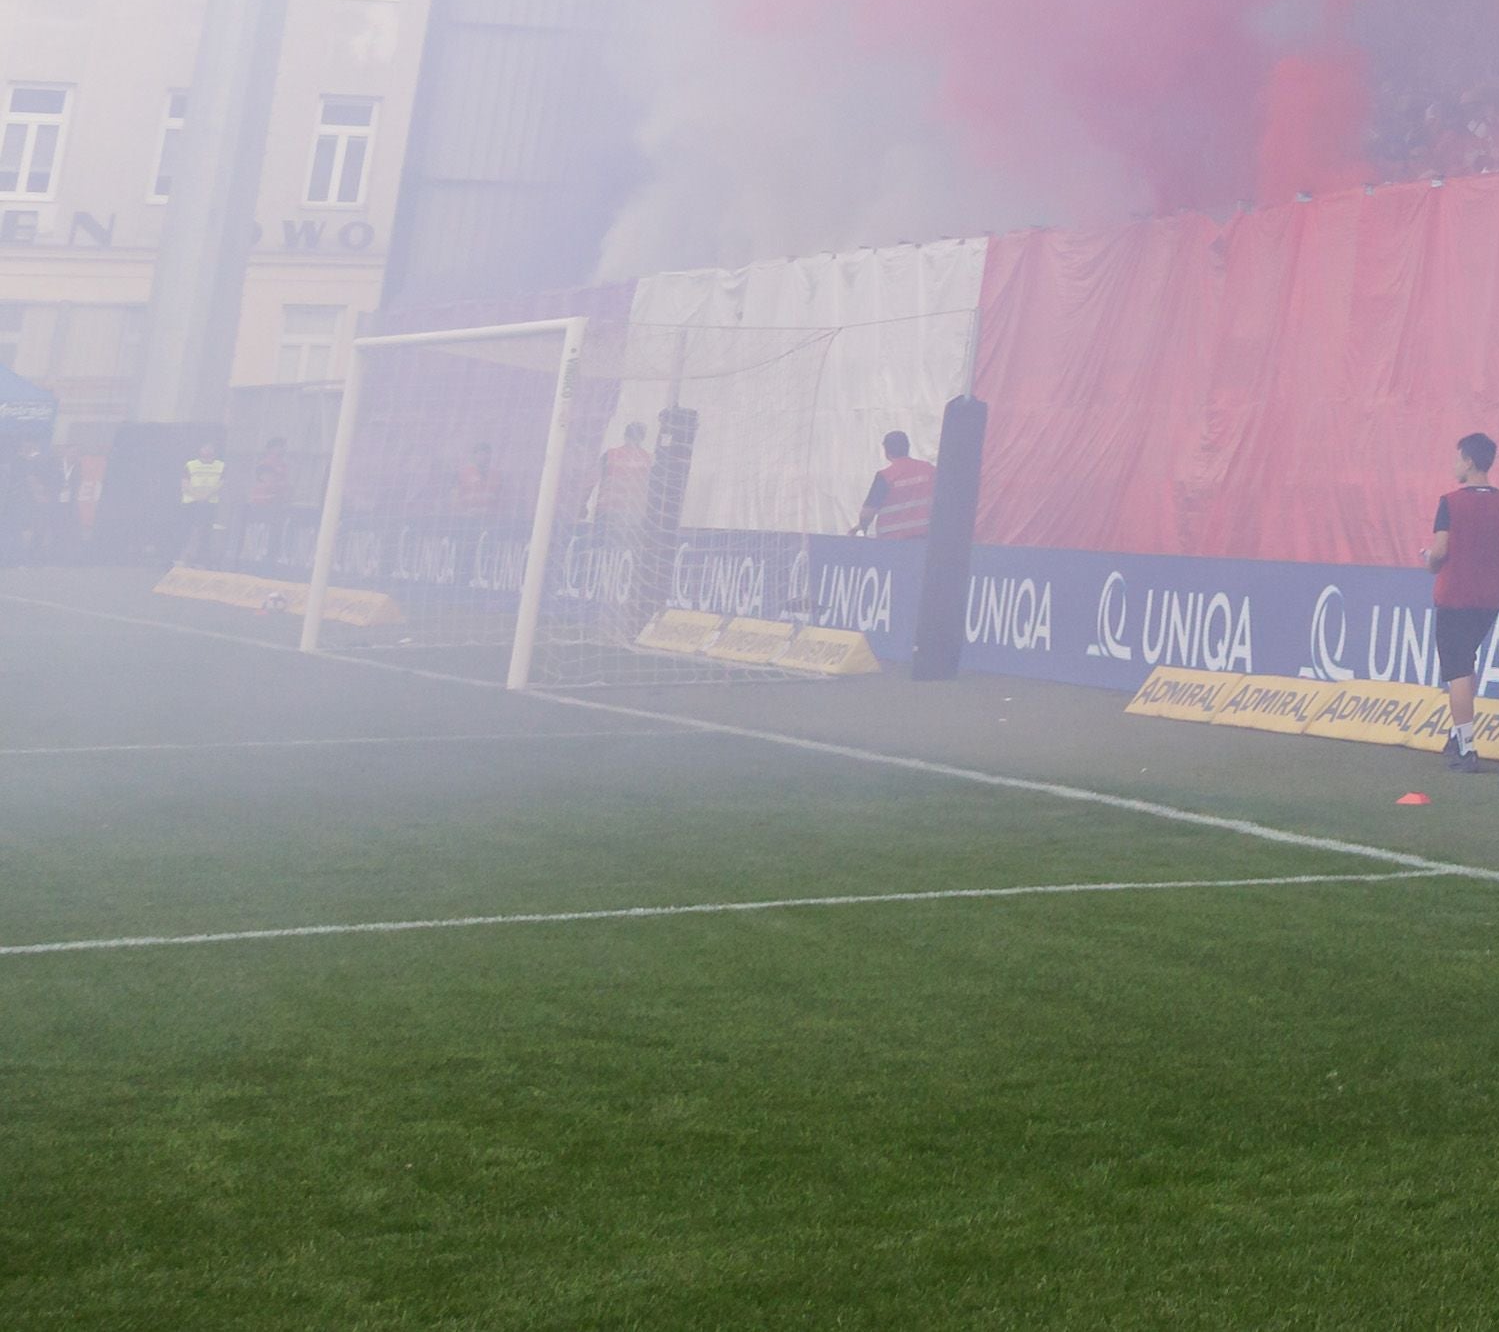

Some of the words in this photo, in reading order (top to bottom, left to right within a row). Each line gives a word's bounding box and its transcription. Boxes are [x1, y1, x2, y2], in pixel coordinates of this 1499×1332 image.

[699, 554, 766, 619] UNIQA
[818, 564, 892, 633] UNIQA
[965, 575, 1051, 651] UNIQA
[1142, 589, 1252, 673] UNIQA
[1132, 676, 1226, 712] ADMIRAL
[1220, 683, 1318, 723] ADMIRAL
[1316, 690, 1424, 732] ADMIRAL
